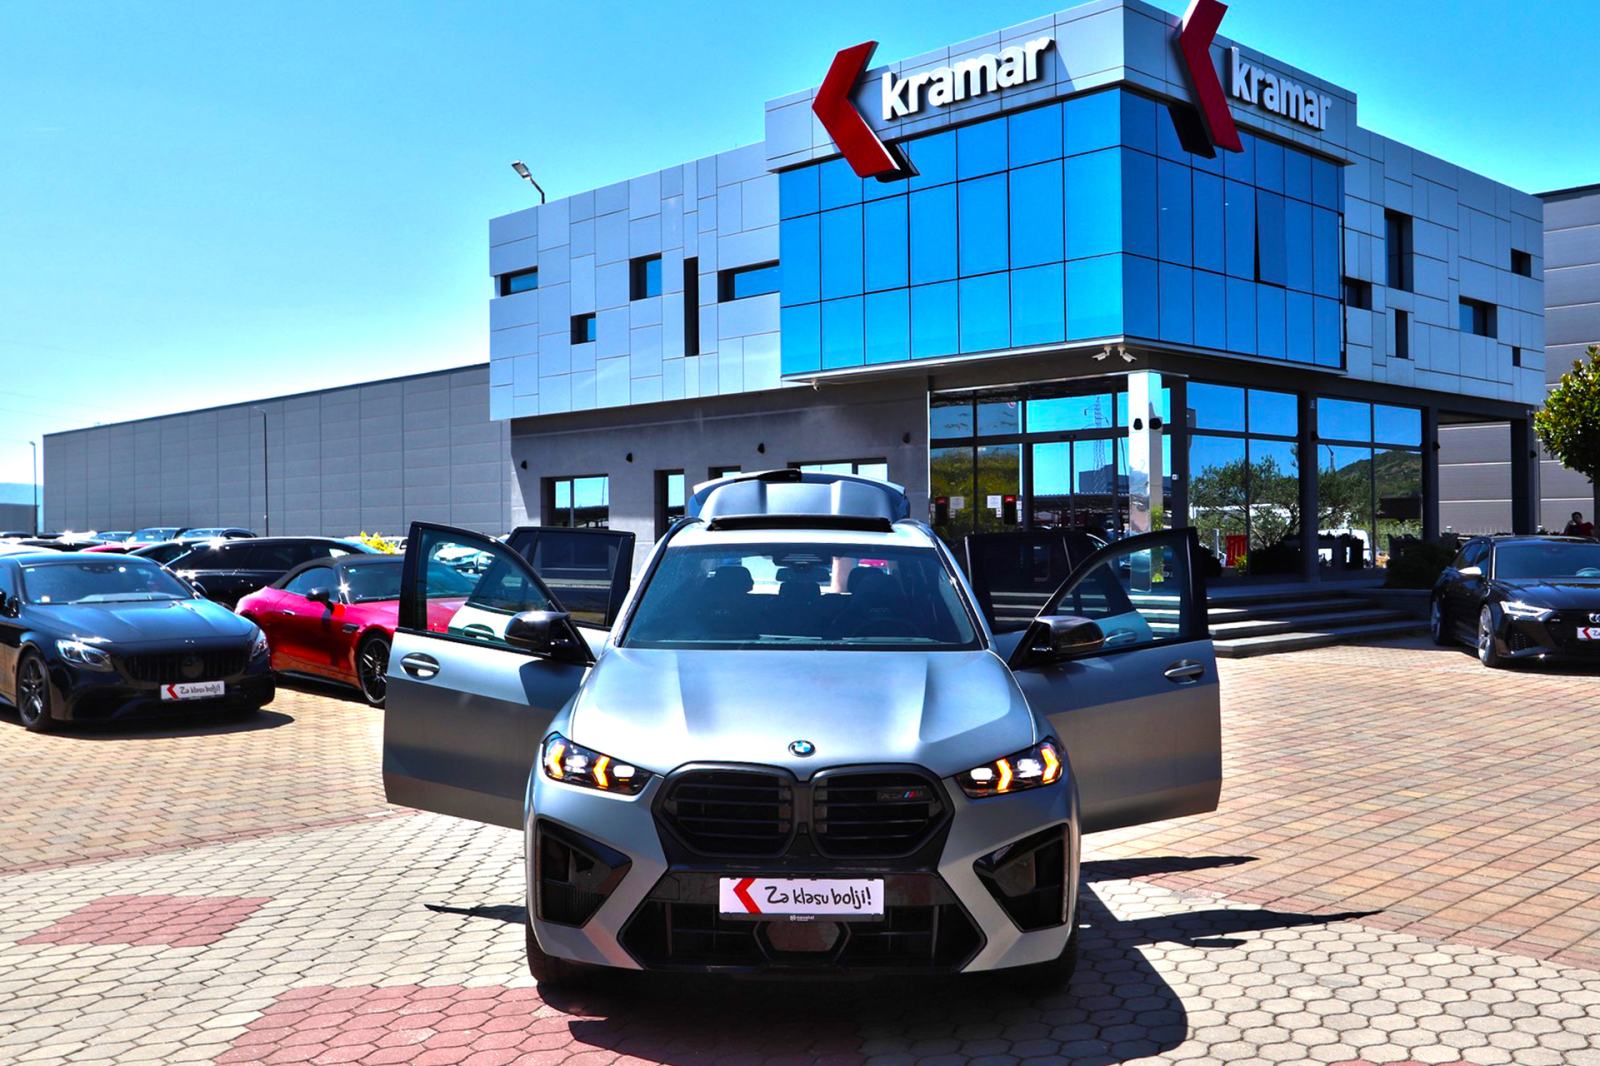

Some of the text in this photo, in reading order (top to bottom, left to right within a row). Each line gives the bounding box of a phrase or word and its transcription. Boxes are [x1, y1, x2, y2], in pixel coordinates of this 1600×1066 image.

[881, 37, 1052, 121] kramar
[1231, 46, 1332, 130] kramar
[764, 885, 872, 910] Za klasu bolji!
